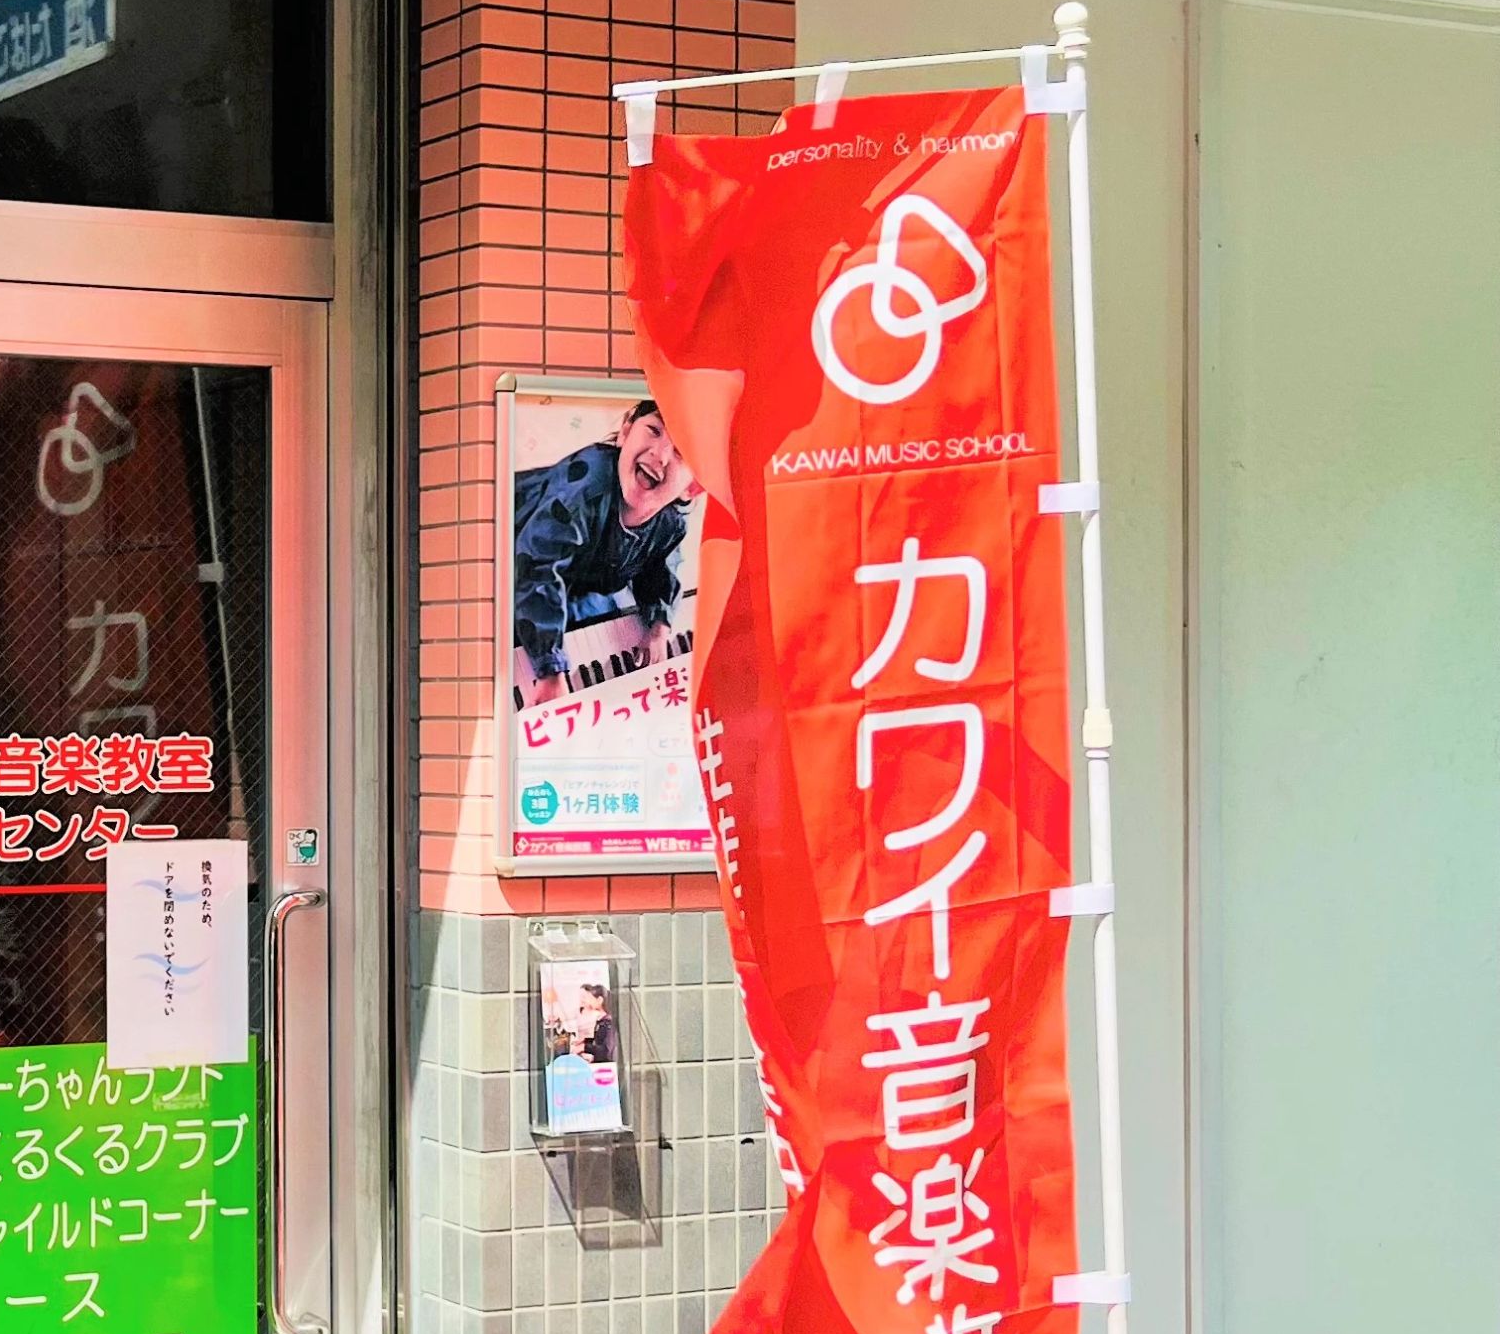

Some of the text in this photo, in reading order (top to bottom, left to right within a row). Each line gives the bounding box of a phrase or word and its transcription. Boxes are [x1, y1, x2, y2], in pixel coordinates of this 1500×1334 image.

[766, 130, 1018, 172] personality & harmon
[772, 432, 1035, 475] KAWAI MUSIC SCHOOL
